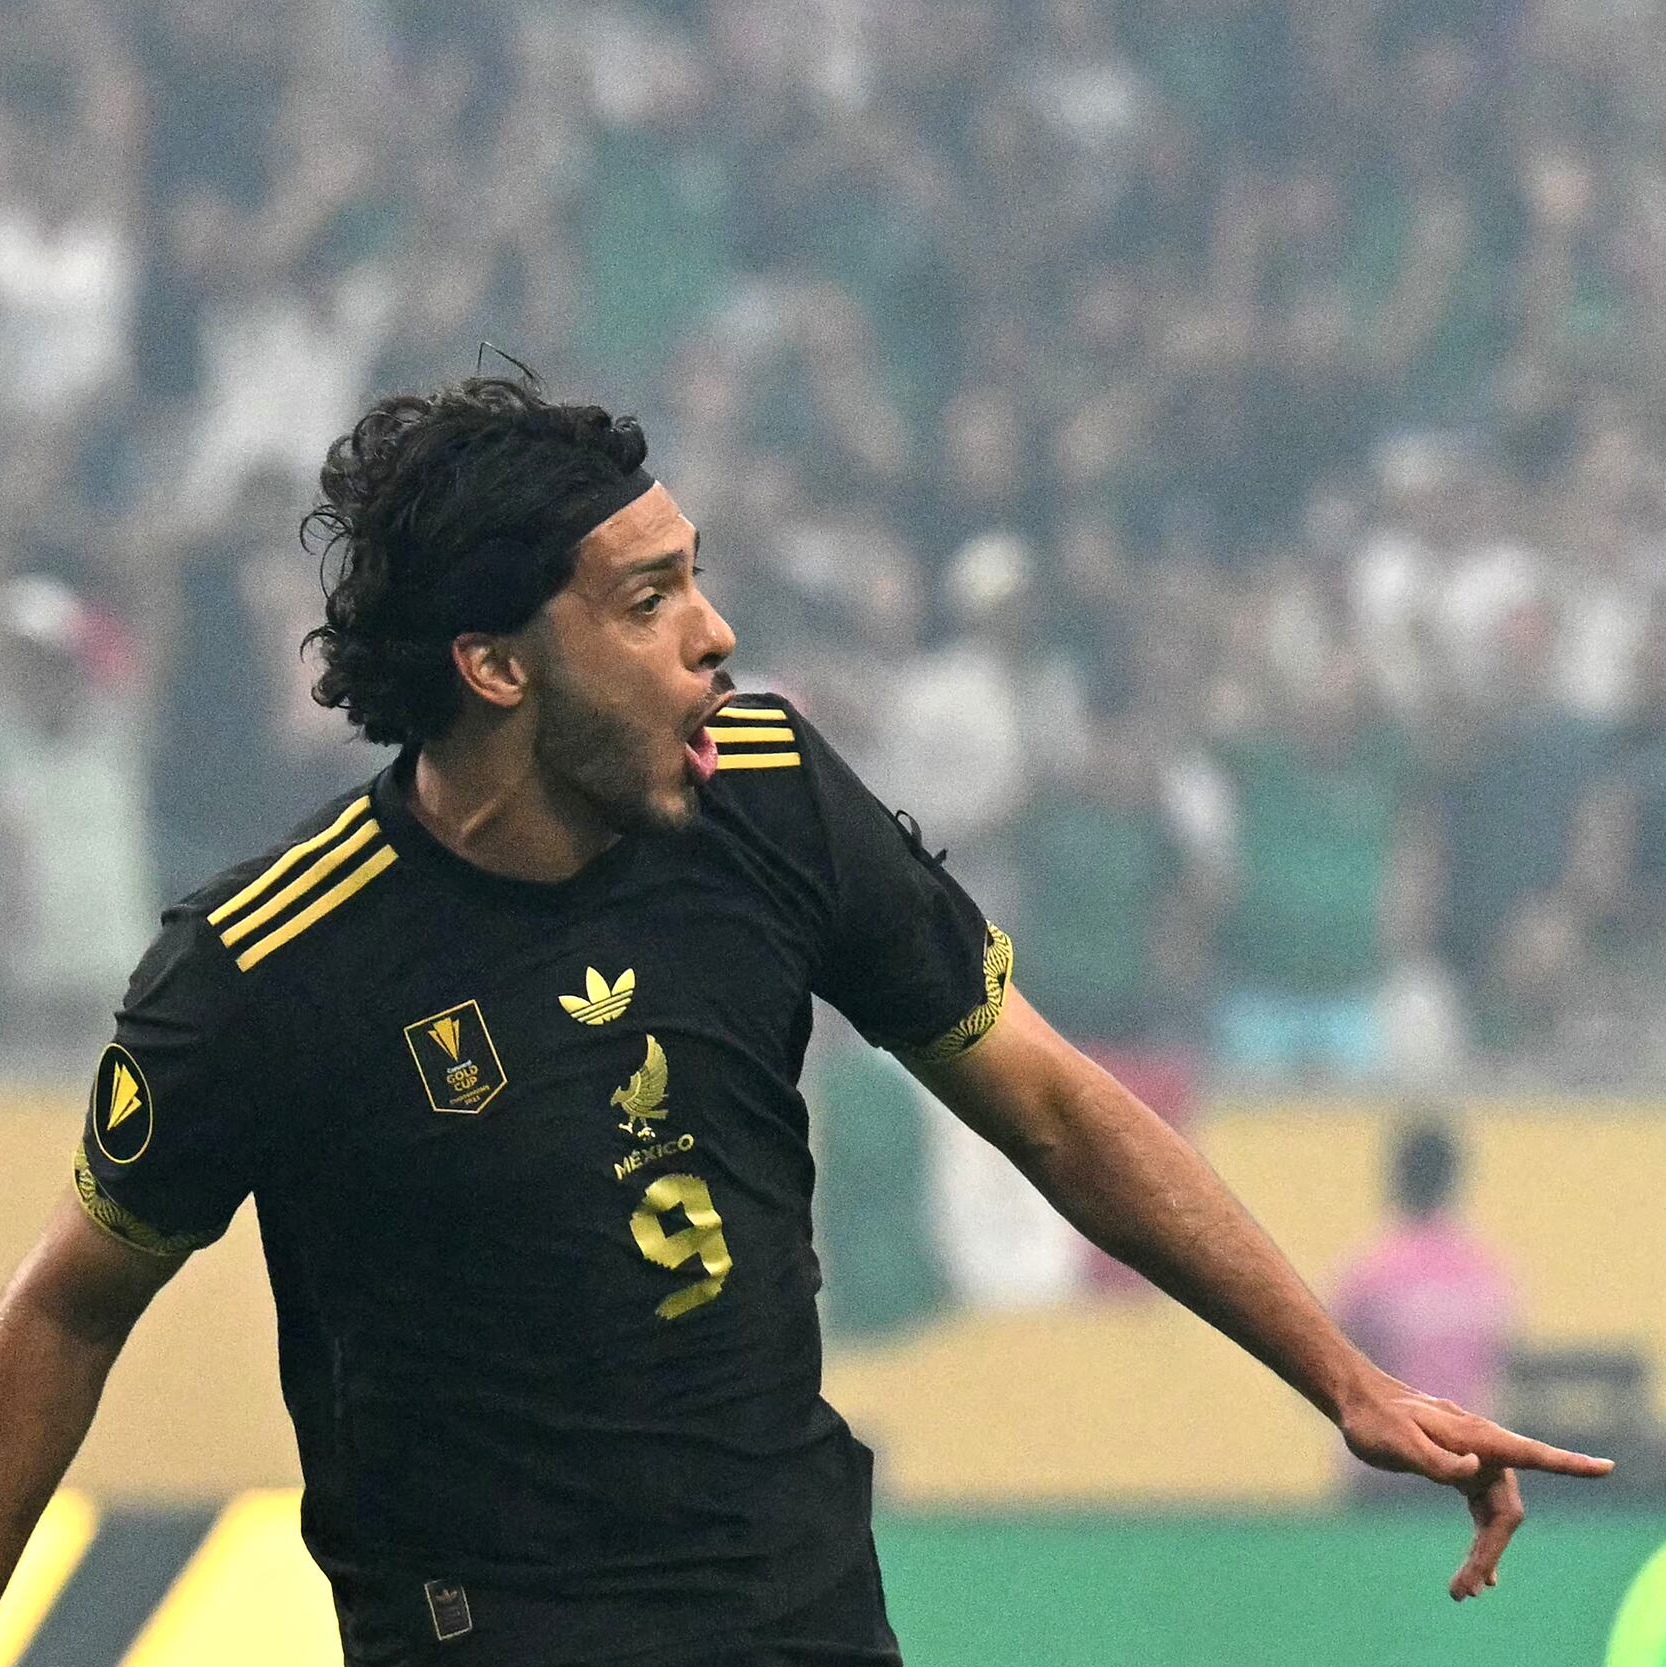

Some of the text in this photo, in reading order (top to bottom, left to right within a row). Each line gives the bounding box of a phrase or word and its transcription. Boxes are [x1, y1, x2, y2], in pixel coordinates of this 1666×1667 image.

[447, 1065, 478, 1084] GOLD
[454, 1076, 478, 1091] CUP
[630, 1173, 733, 1320] 9
